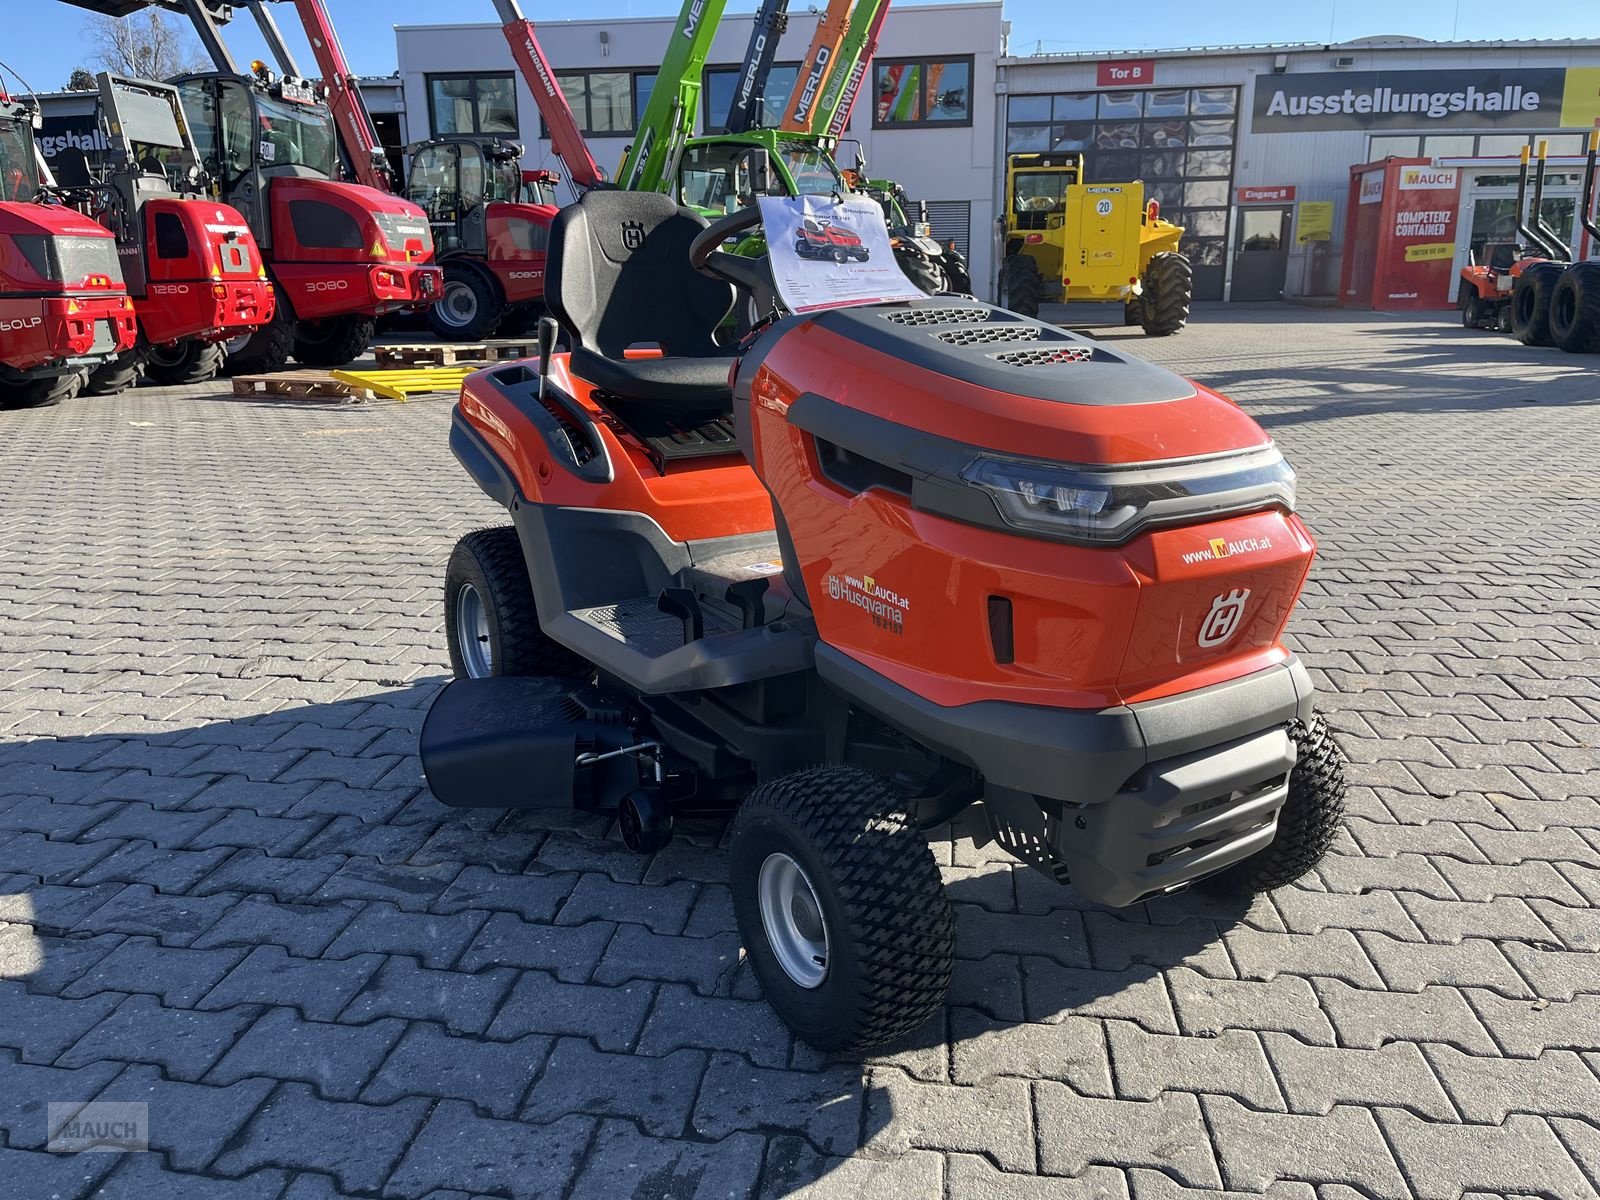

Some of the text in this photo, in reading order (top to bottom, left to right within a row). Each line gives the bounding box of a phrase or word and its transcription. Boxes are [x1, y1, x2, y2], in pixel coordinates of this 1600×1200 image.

[683, 0, 704, 38] ME
[525, 38, 556, 97] WEIDEMANN
[738, 35, 767, 110] MERLO
[1110, 67, 1141, 79] Tor B
[794, 47, 830, 122] MERLO
[1266, 86, 1539, 118] Ausstellungshalle
[637, 148, 649, 174] 35.7
[1407, 173, 1453, 184] MAUCH
[1245, 191, 1279, 199] Eingang
[1099, 202, 1110, 213] 20
[1396, 211, 1451, 224] KOMPETENZ
[1395, 223, 1445, 236] CONTAINER
[153, 285, 188, 294] 1280
[305, 280, 348, 292] 3080
[0, 317, 42, 331] 60LP
[1182, 536, 1272, 565] www.MAUCH.at
[844, 574, 910, 611] www.MAUCH.at
[840, 582, 903, 625] Husqvarna
